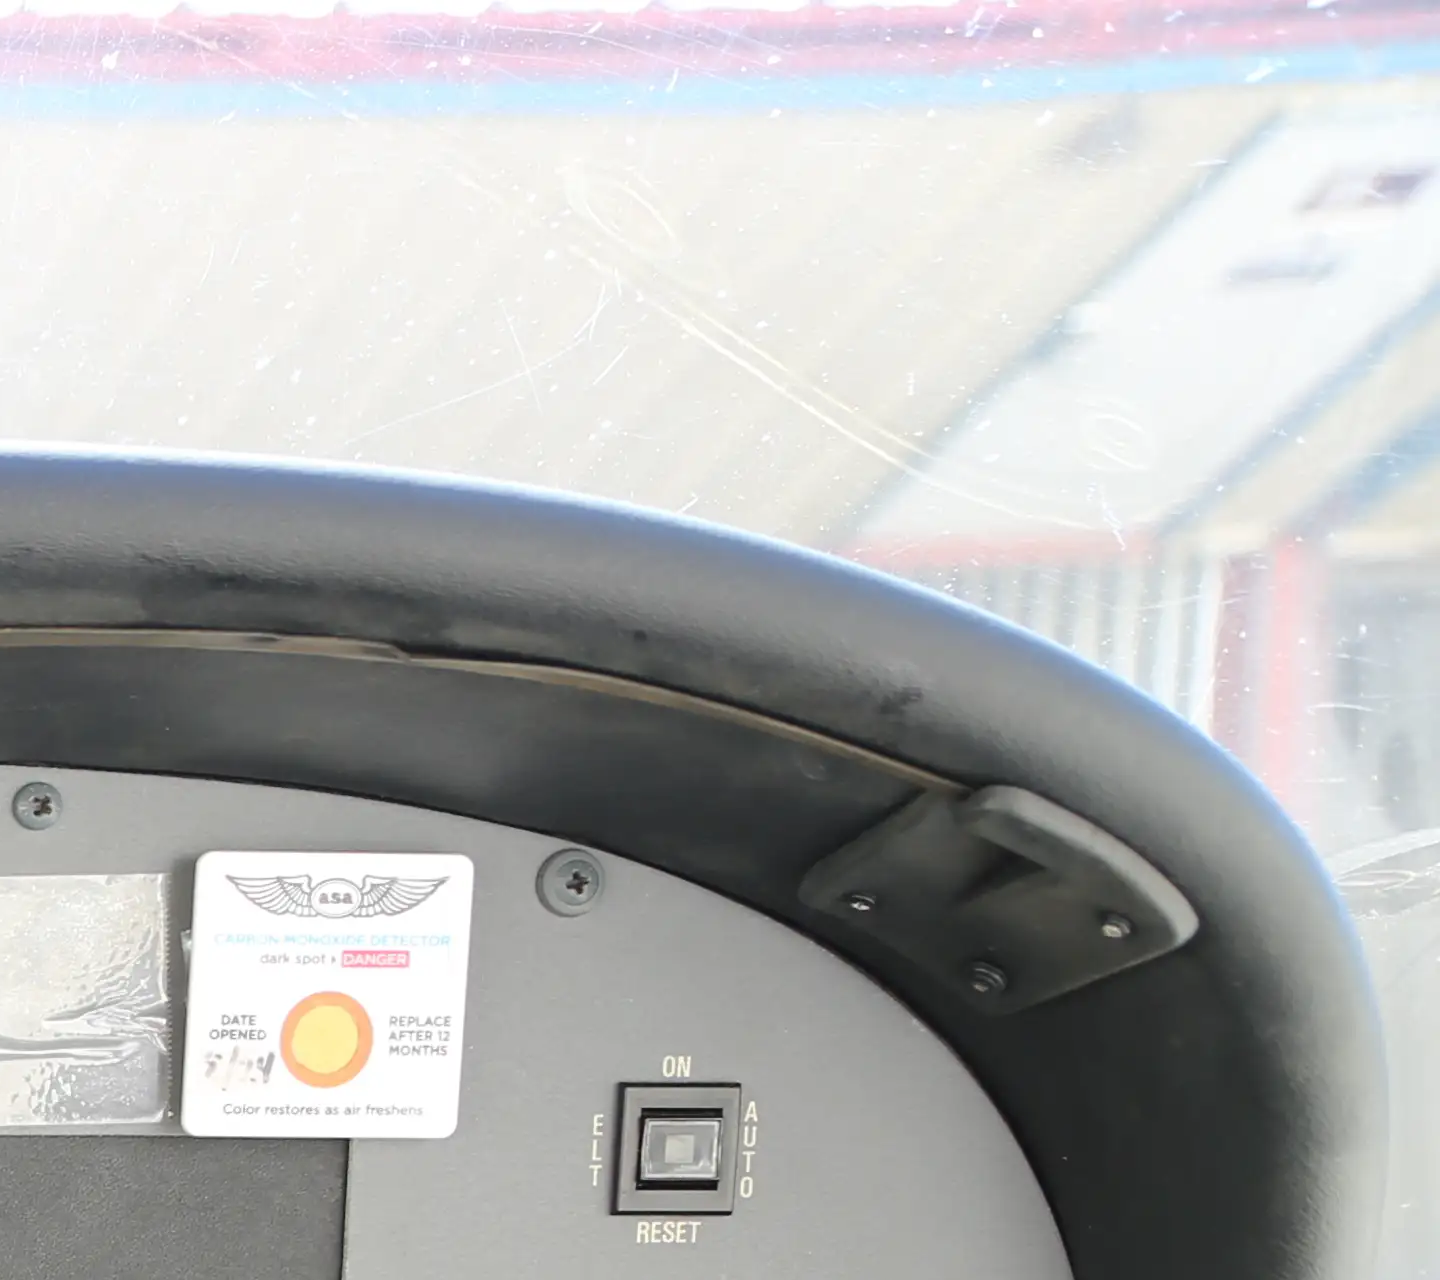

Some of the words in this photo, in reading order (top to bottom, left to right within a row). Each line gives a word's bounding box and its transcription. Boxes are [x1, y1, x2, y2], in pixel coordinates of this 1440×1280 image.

[343, 953, 407, 966] DANGER
[220, 1014, 257, 1027] DATE
[389, 1015, 452, 1028] REPLACE
[209, 1028, 267, 1041] OPENED
[388, 1029, 433, 1042] AFTER
[437, 1030, 451, 1042] 12
[388, 1044, 448, 1057] MONTHS
[662, 1055, 692, 1078] ON
[636, 1220, 702, 1244] RESET
